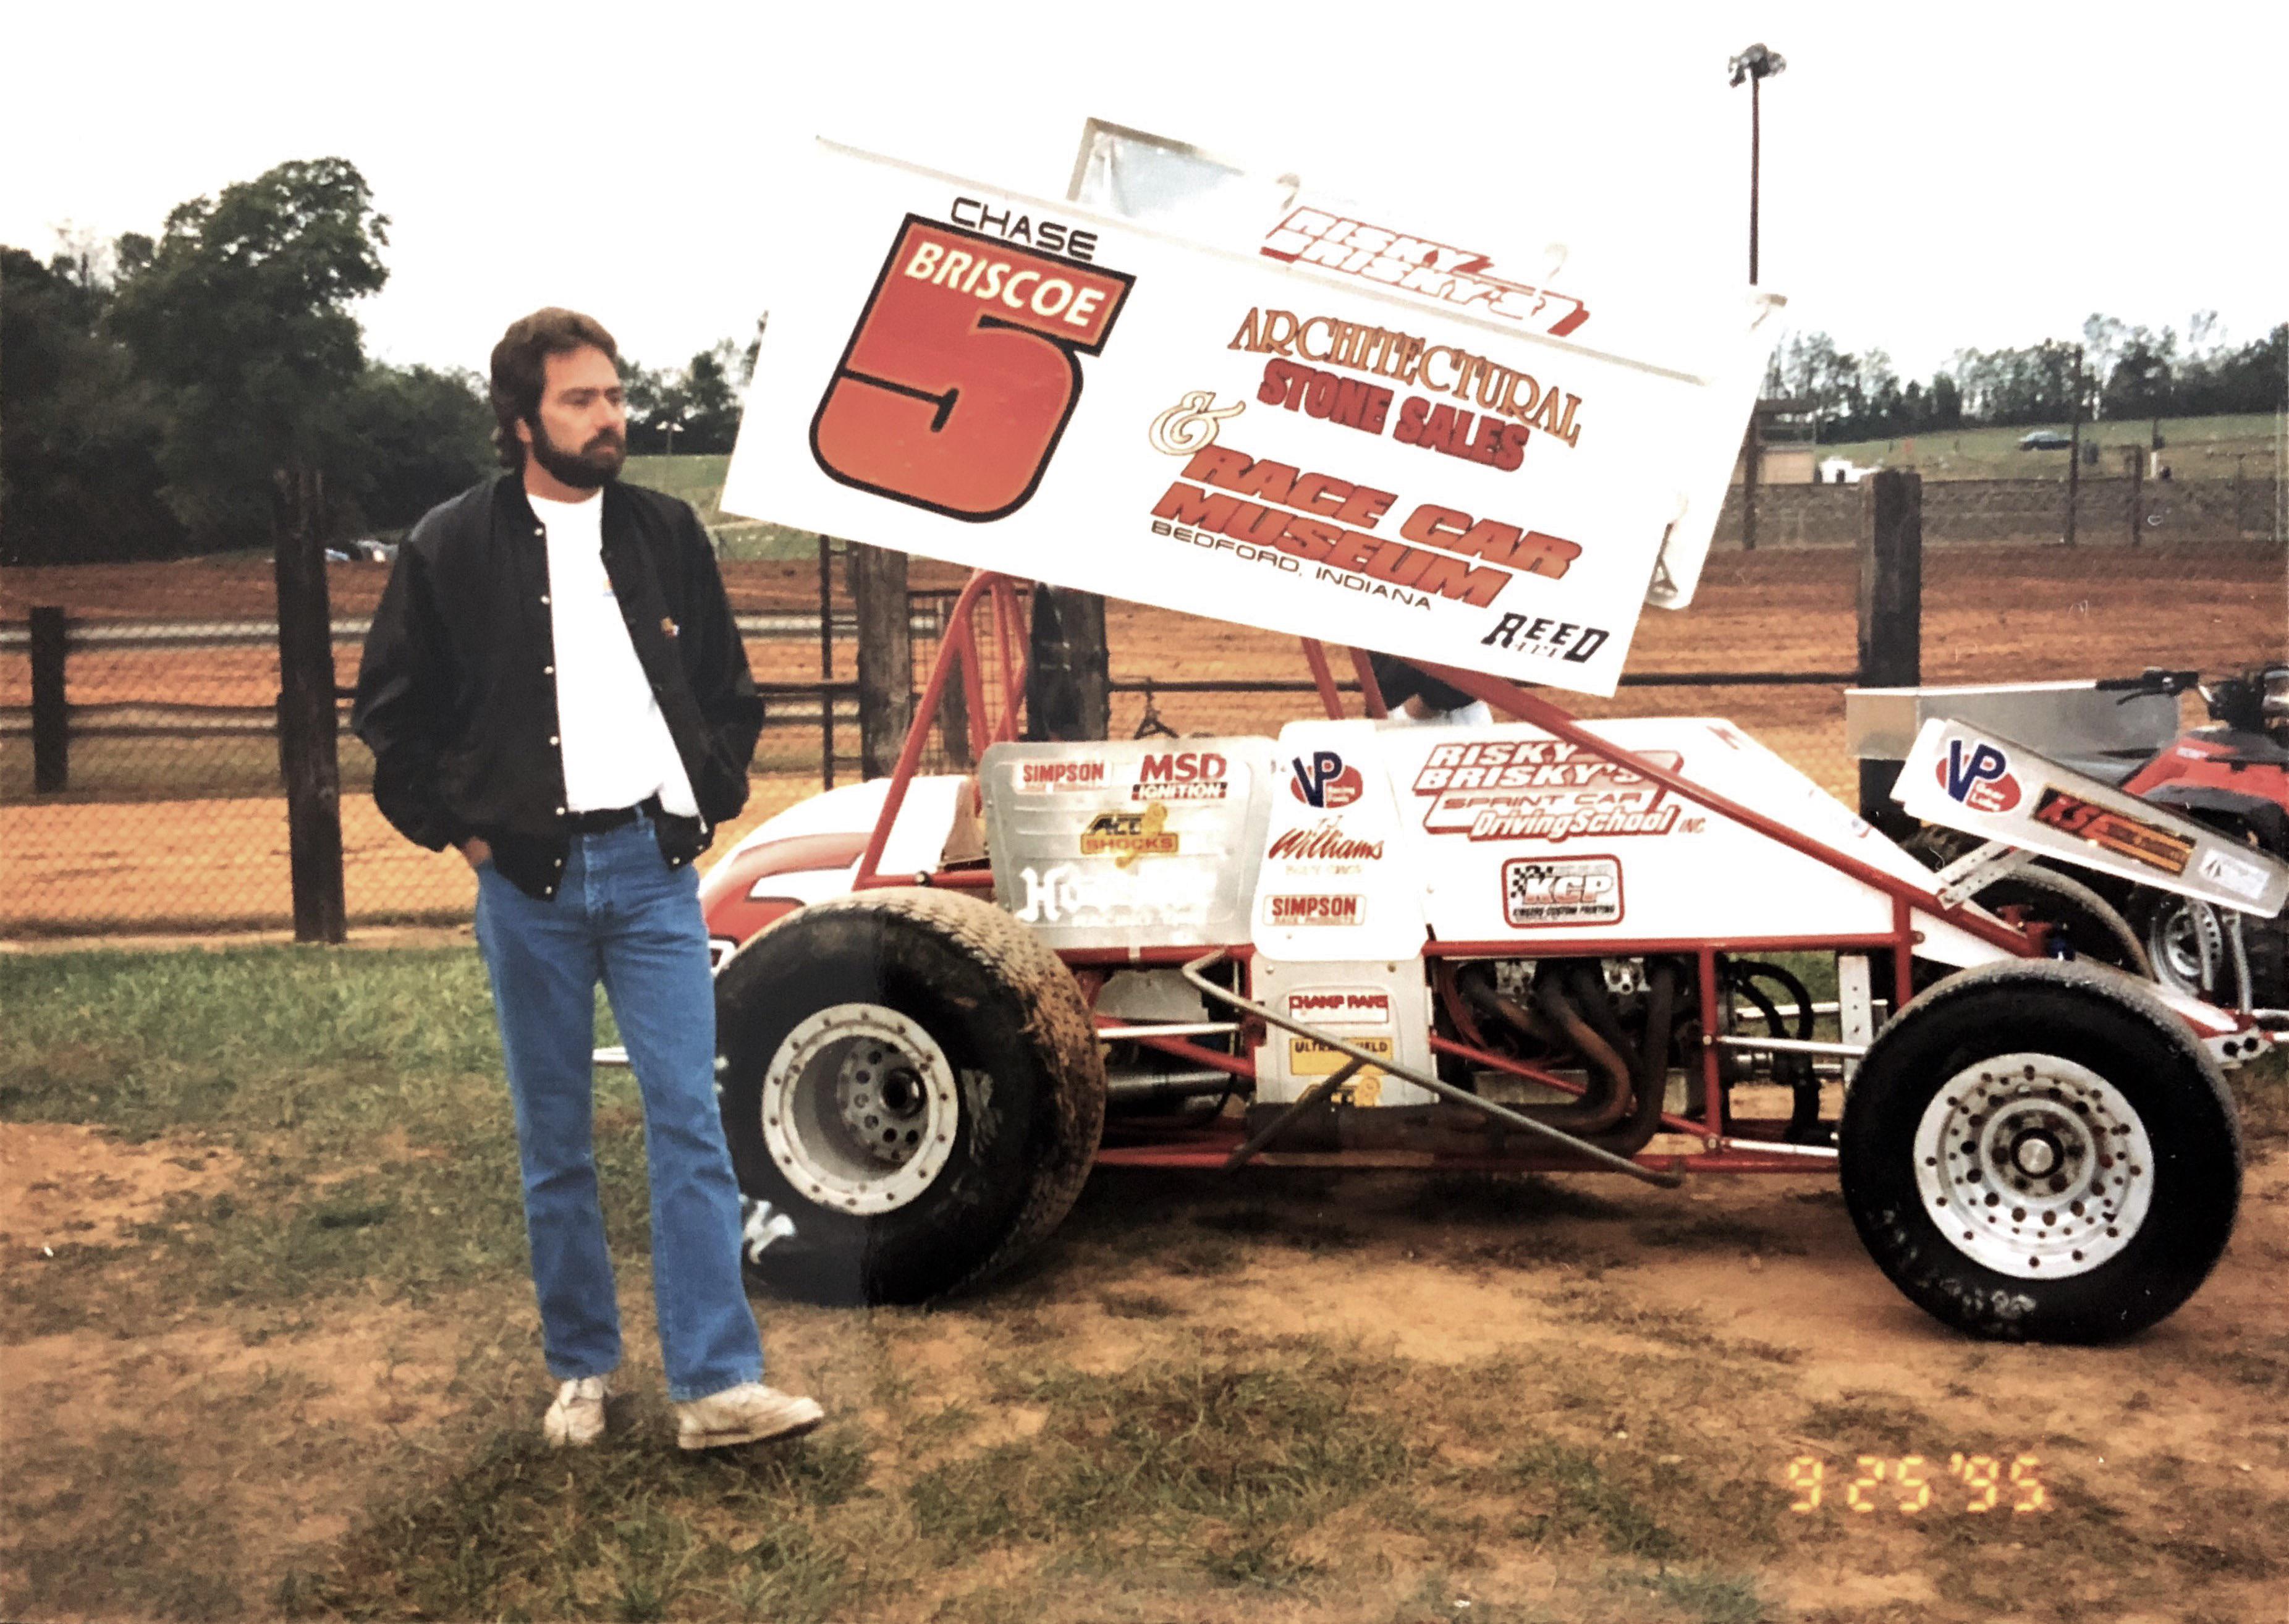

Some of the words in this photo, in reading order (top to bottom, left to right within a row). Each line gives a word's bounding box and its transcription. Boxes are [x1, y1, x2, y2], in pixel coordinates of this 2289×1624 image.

[950, 196, 1098, 261] CHASE
[904, 241, 1105, 327] BRISCOE
[808, 211, 1138, 523] 5
[1227, 307, 1582, 448] ARCHITECTURAL
[1256, 357, 1395, 435] STONE
[1148, 391, 1246, 456] &
[1392, 395, 1530, 472] SALES
[1180, 444, 1399, 530] RACE
[1399, 503, 1583, 581] CAR
[1150, 481, 1513, 609] MUSEUM
[1316, 566, 1431, 611] INDIANA
[1480, 612, 1610, 664] REED
[1023, 760, 1105, 783] SIMPSON
[1140, 753, 1227, 782] MSD
[1292, 751, 1342, 808] VP
[1428, 743, 1579, 765] RISKY
[1948, 739, 2007, 803] VP
[1139, 783, 1221, 799] IGNITION
[1442, 794, 1565, 810] SPRINT
[1574, 792, 1642, 805] CAR
[1086, 837, 1174, 852] SHOCKS
[1269, 827, 1385, 860] Williams
[1272, 897, 1356, 916] SIMPSON
[1522, 874, 1614, 905] KCP
